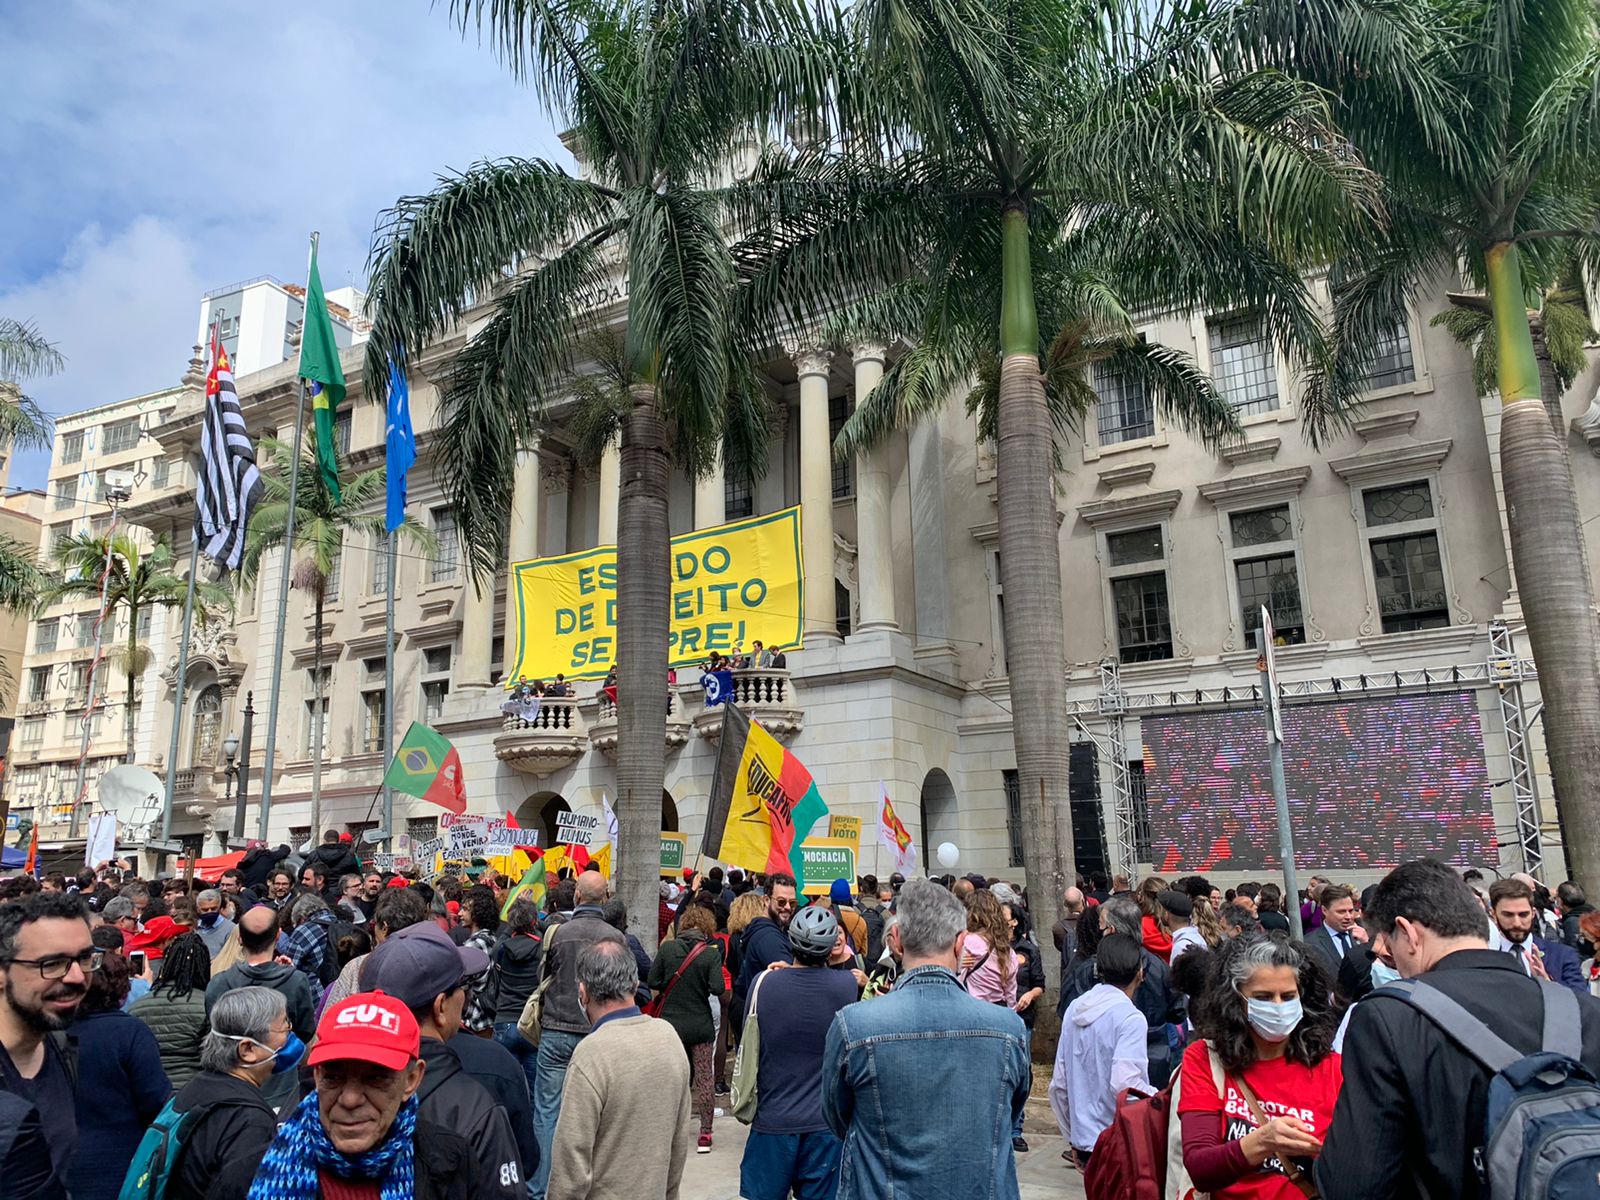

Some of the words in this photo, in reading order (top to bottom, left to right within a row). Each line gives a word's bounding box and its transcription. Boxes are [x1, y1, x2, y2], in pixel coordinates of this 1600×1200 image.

[578, 546, 730, 595] ESDO
[556, 603, 594, 635] DE
[607, 578, 767, 625] DEITO
[571, 620, 745, 668] SEPRE!
[450, 825, 469, 833] QUEL
[451, 830, 477, 841] MONDE
[560, 828, 592, 845] HUMUS
[833, 829, 857, 839] VOTO
[802, 850, 848, 863] MOCRACIA
[336, 1004, 395, 1028] CUT
[499, 1160, 520, 1187] 88
